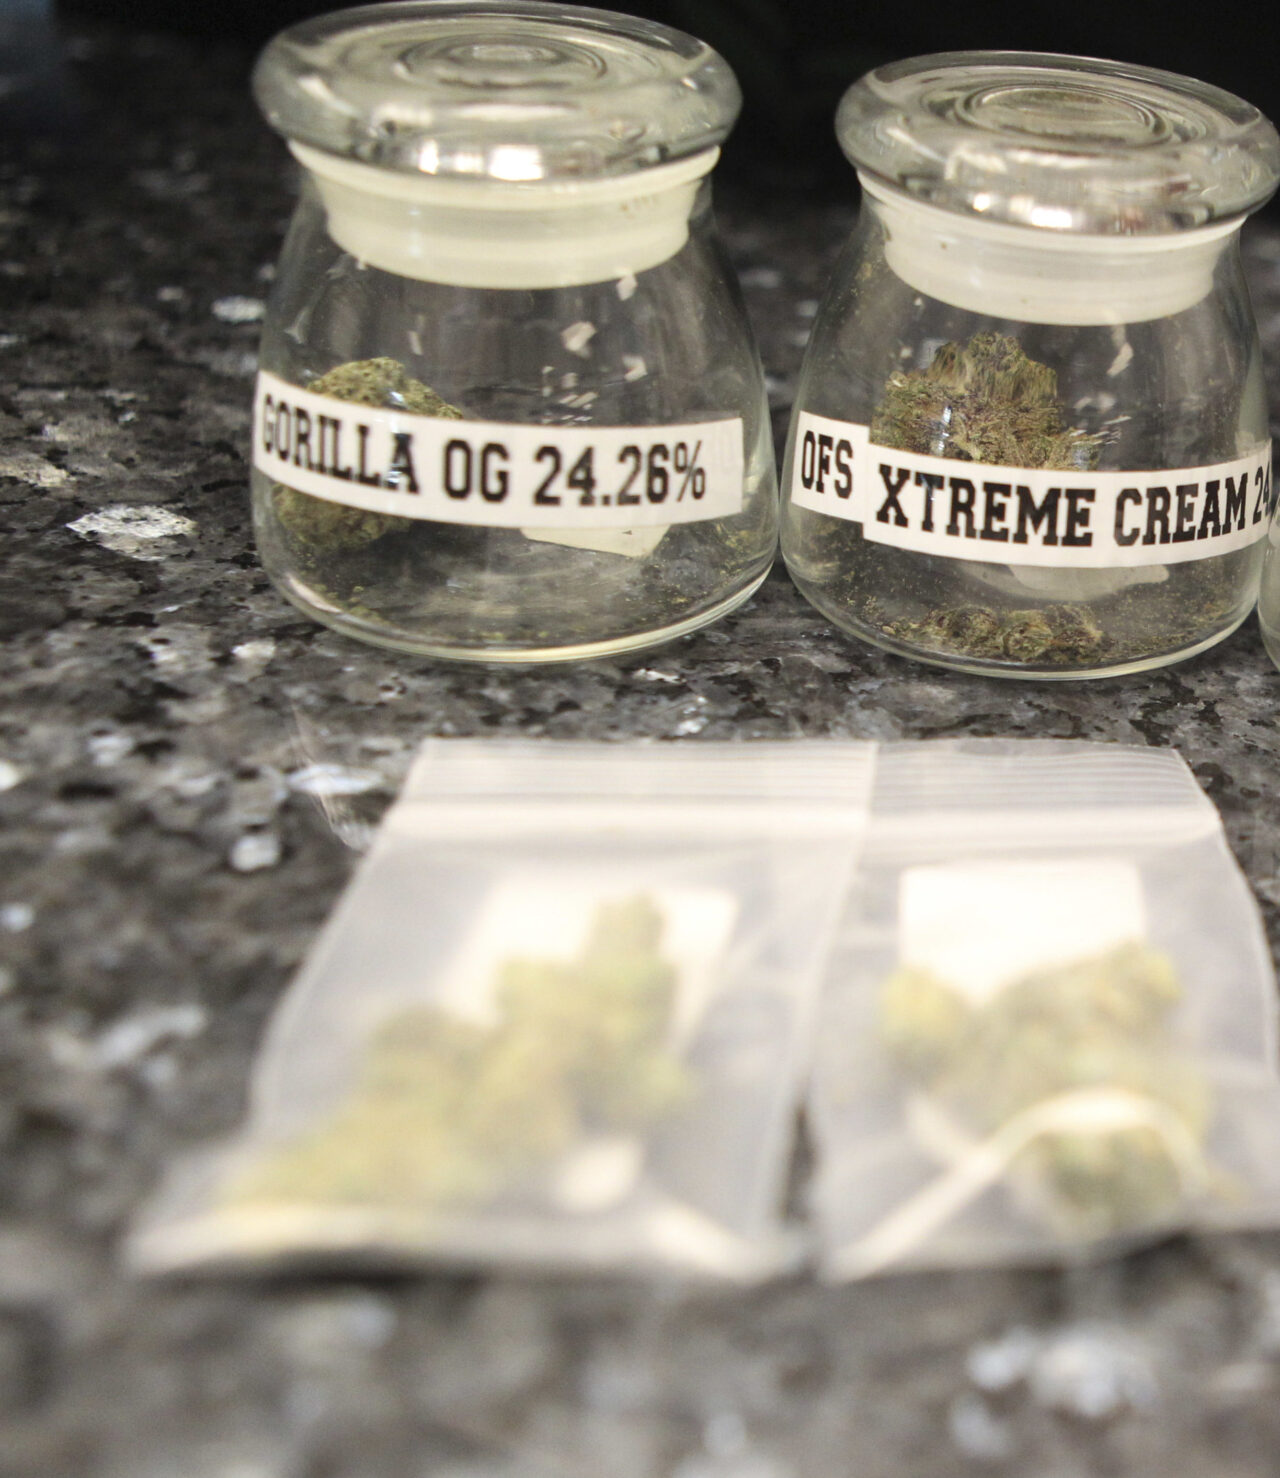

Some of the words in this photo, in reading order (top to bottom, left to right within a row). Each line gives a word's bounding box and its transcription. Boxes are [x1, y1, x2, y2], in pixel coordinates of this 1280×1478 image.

[262, 393, 420, 494] GORILLA
[443, 439, 510, 502] OG
[532, 440, 706, 506] 24.26%
[801, 430, 853, 500] OFS
[876, 463, 1096, 548] XTREME
[1113, 472, 1248, 547] CREAM
